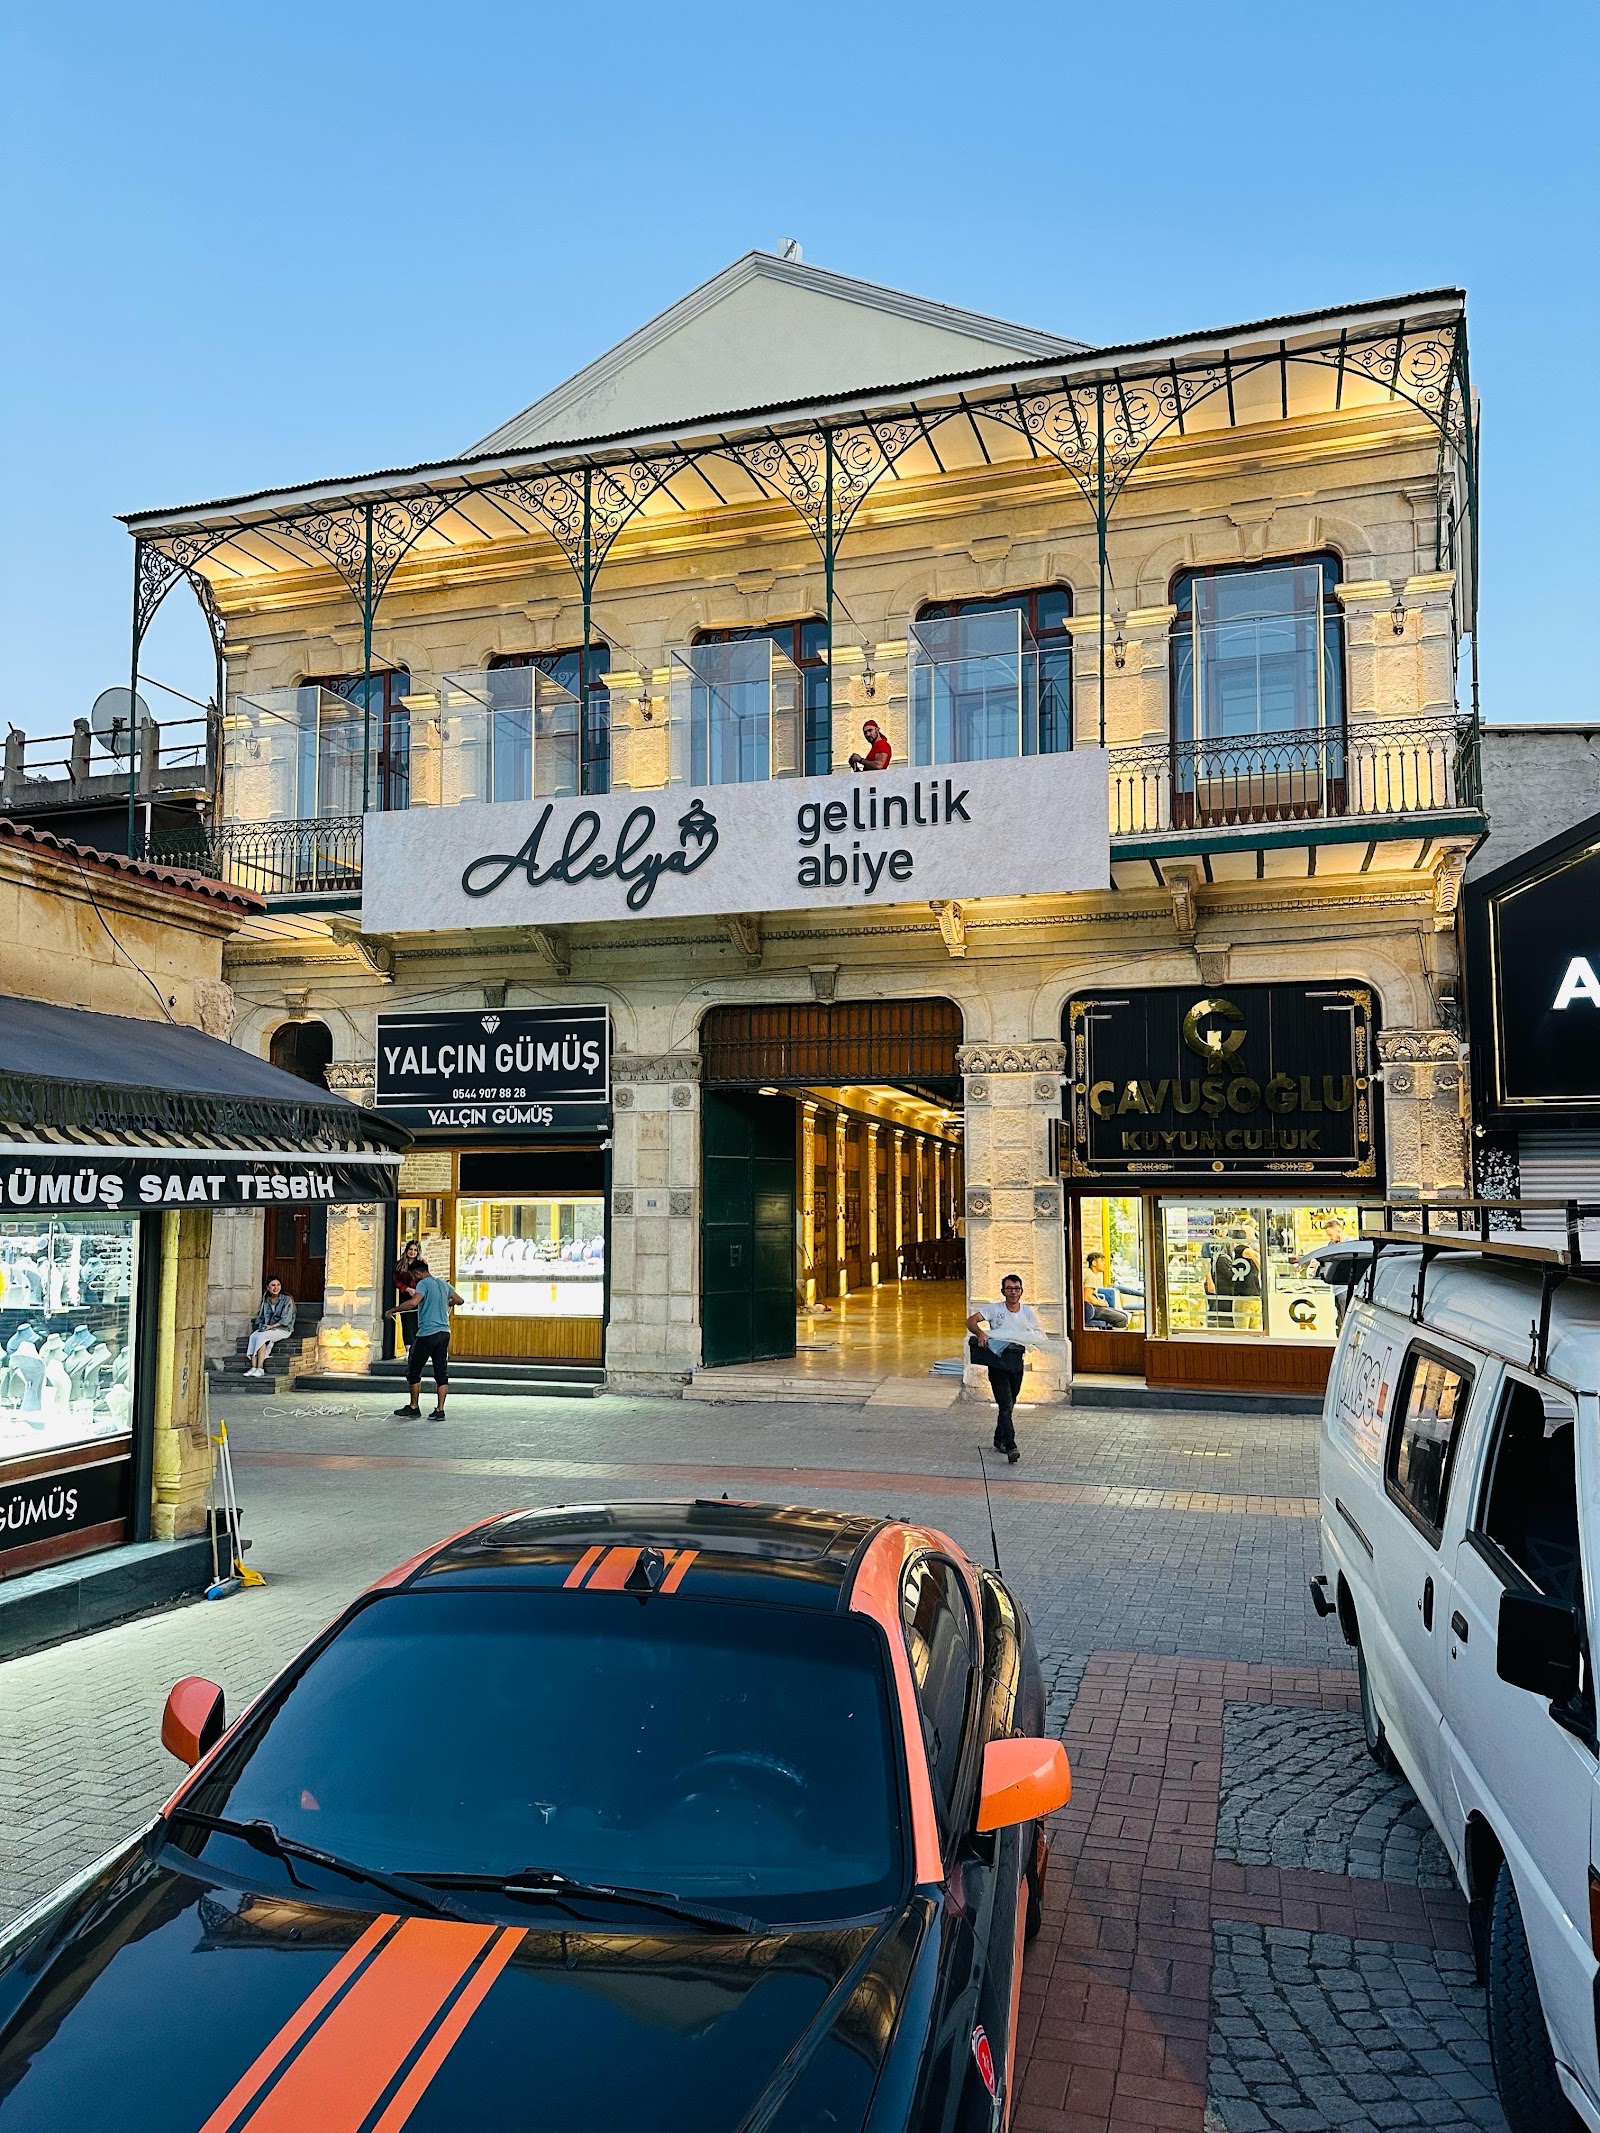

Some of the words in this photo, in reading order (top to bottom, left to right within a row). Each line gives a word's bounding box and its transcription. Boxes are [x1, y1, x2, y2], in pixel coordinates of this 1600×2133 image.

[798, 779, 971, 847] gelinlik
[462, 803, 718, 911] Adelya
[798, 841, 914, 895] abiye
[384, 1044, 486, 1078] YALÇIN
[495, 1034, 600, 1075] GÜMÜŞ
[452, 1088, 477, 1099] 0544
[479, 1088, 497, 1099] 907
[499, 1087, 512, 1099] 88
[513, 1087, 527, 1099] 28
[1089, 1072, 1354, 1120] ÇAVUŞOĞLU
[428, 1108, 487, 1128] YALÇIN
[492, 1105, 553, 1127] GÜMÜŞ
[1121, 1129, 1321, 1151] KUYUMCULUK
[0, 1168, 124, 1210] ÜMÜŞ
[139, 1174, 226, 1203] SAAT
[237, 1171, 336, 1201] TESBİH
